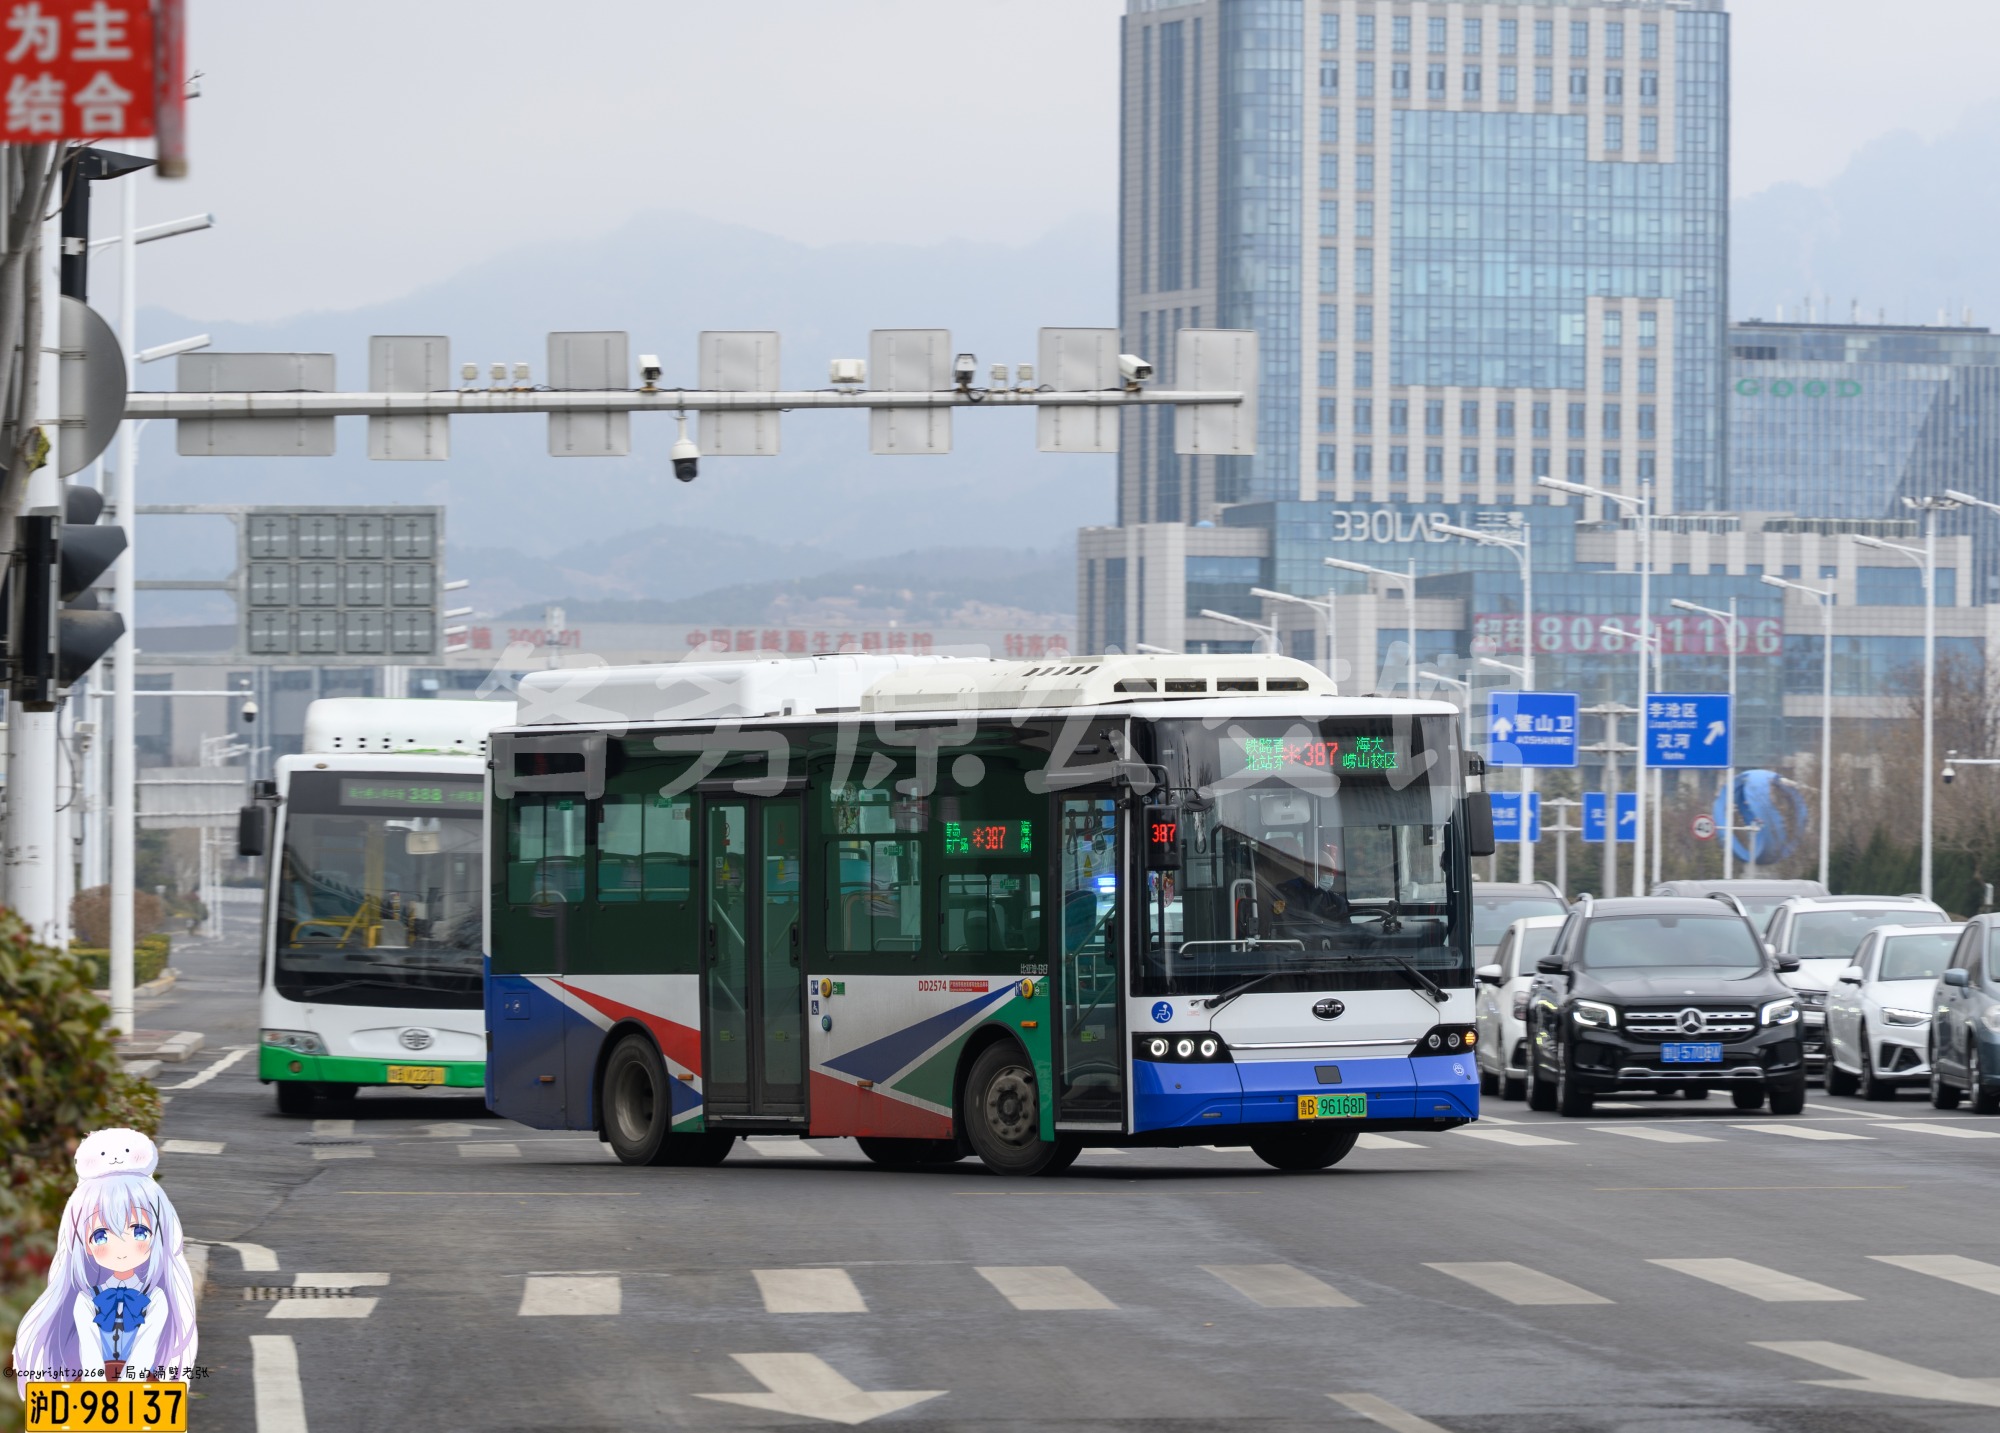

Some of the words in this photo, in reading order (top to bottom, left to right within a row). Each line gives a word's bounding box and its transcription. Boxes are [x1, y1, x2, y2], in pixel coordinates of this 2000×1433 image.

[6, 2, 132, 63] 为主
[6, 71, 134, 134] 结合
[1735, 378, 1863, 398] GOOD
[1303, 741, 1339, 767] 387
[1356, 736, 1385, 753] 海大
[1342, 752, 1399, 769] 崂山校区
[408, 787, 443, 801] 388
[985, 826, 1006, 850] 387
[1152, 823, 1177, 843] 387
[918, 980, 947, 992] DD2574
[1316, 1003, 1343, 1014] BYD
